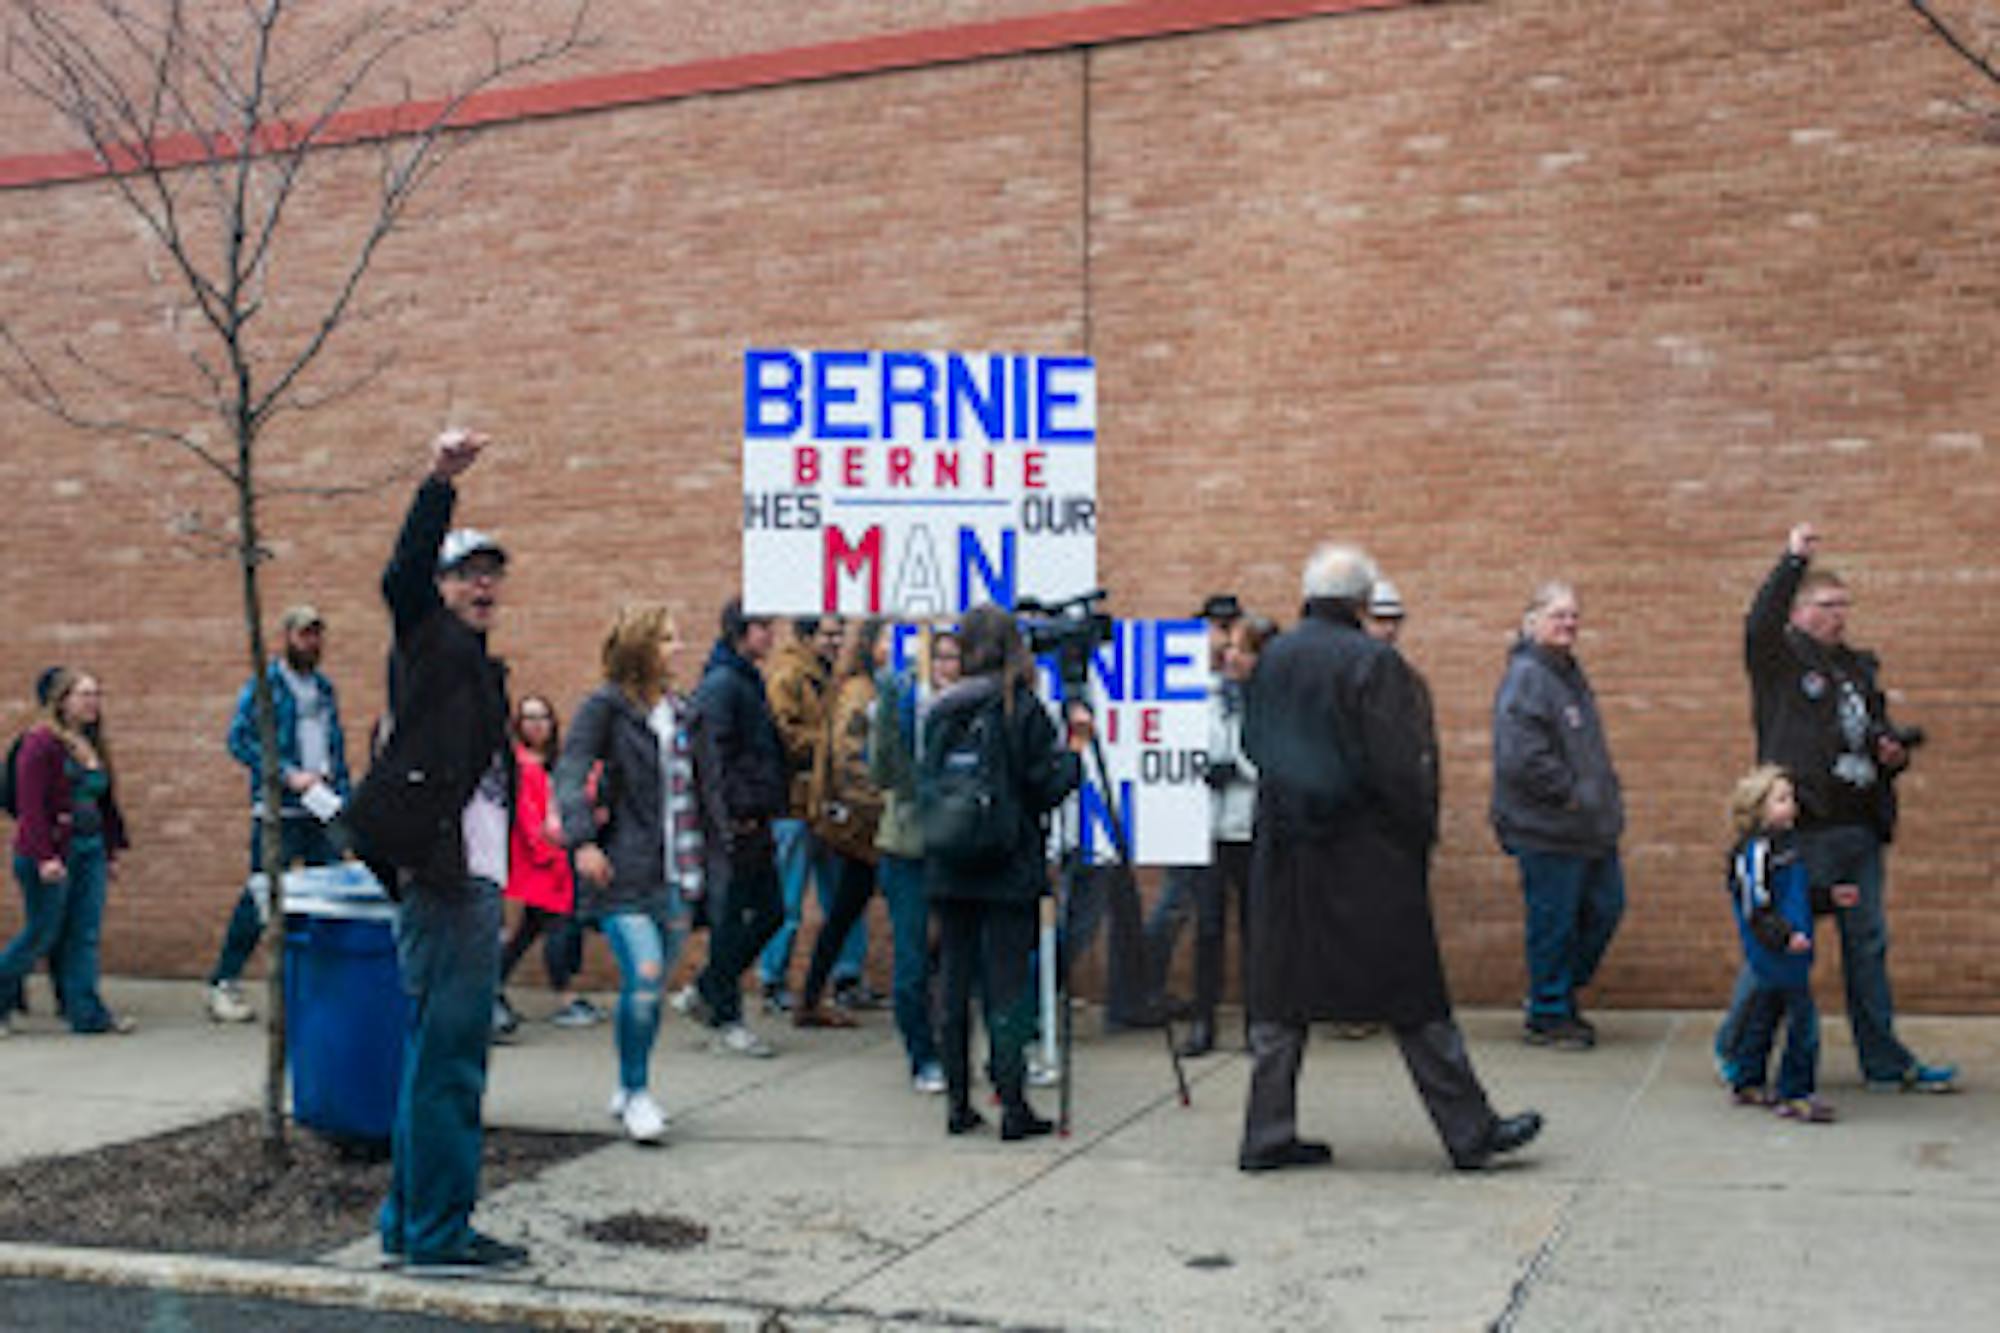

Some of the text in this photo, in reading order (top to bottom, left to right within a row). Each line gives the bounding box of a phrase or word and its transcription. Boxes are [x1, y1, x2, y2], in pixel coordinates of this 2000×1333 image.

[744, 350, 1096, 441] BERNIE
[793, 446, 1048, 489] BERNIE
[744, 494, 1096, 535] HES OUR
[822, 524, 1017, 615] MAN
[1141, 749, 1209, 786] OUR
